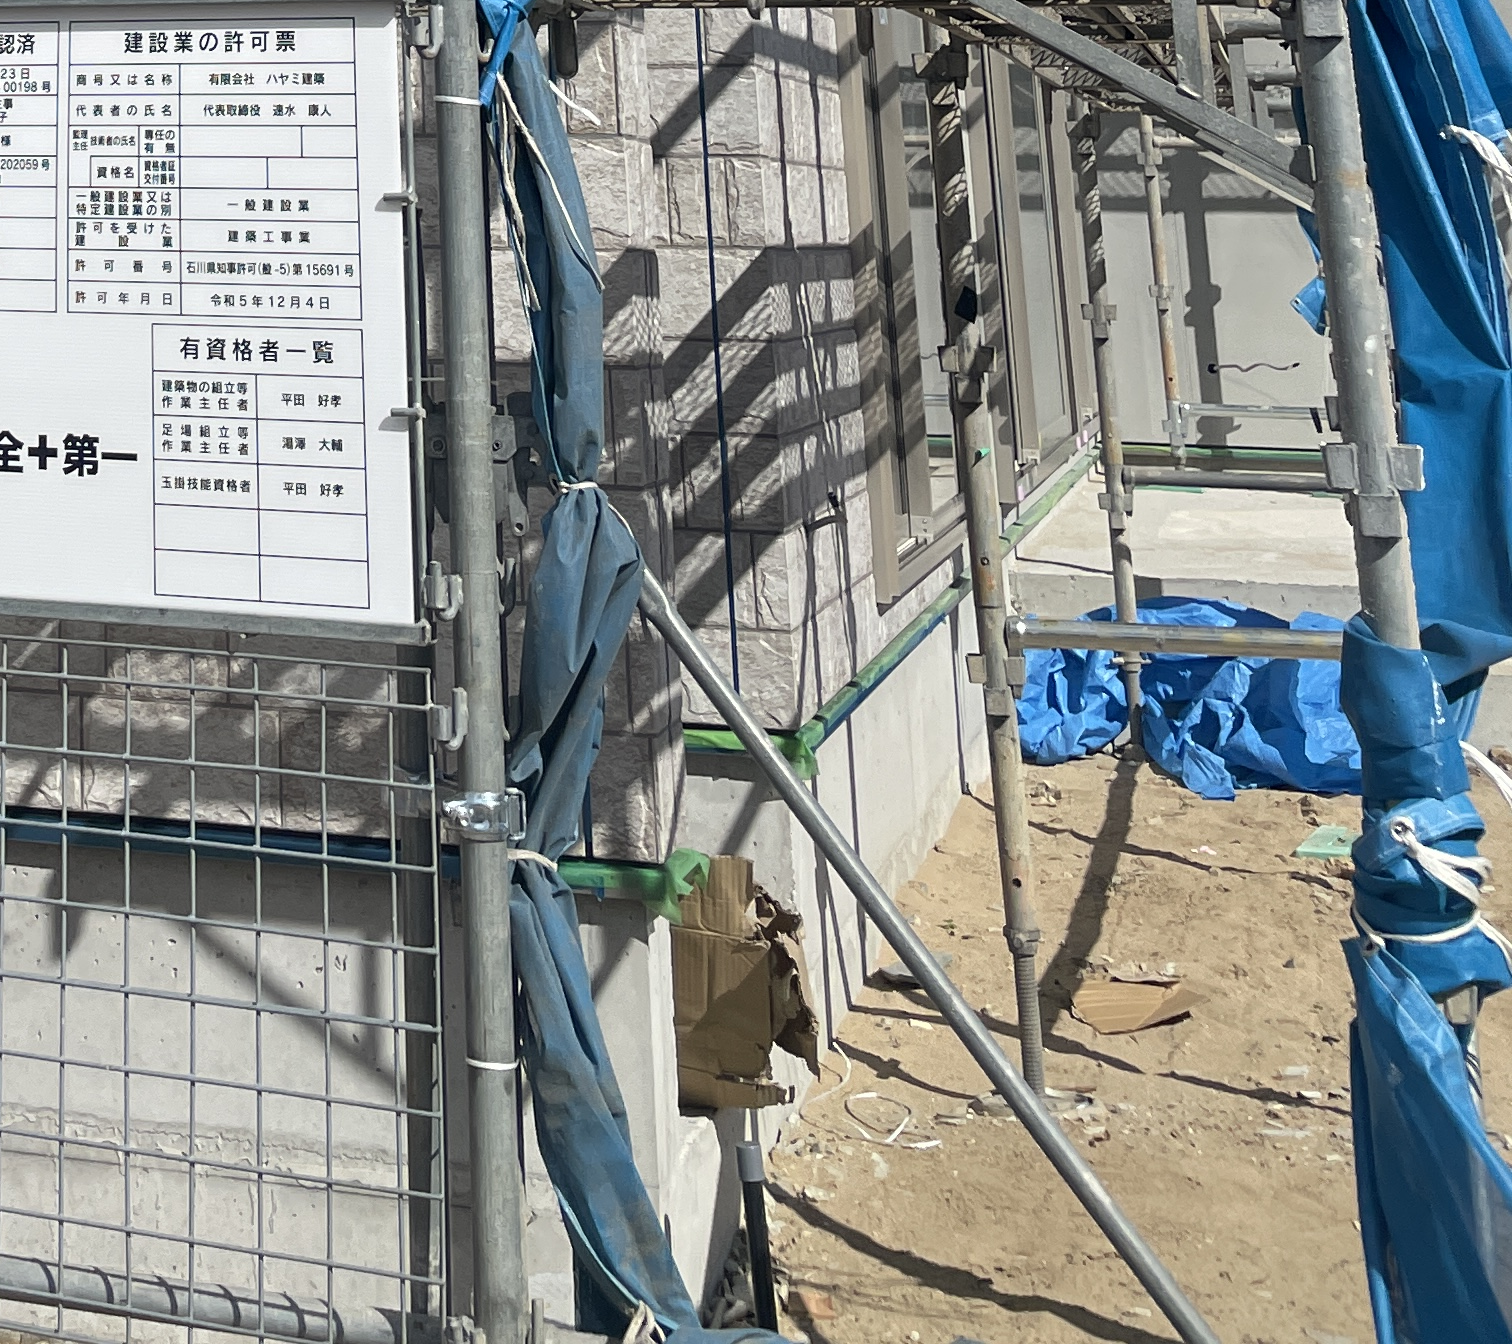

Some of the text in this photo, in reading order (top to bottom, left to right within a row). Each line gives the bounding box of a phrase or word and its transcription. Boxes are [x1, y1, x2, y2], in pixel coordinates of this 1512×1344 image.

[124, 30, 296, 53] 建設業の許可票
[77, 74, 172, 86] 商号又は名称
[209, 73, 324, 85] 有限会社 ハヤミ建築
[76, 104, 171, 116] 代表者の氏名
[204, 104, 260, 116] 代表取締役
[97, 166, 134, 178] 資格名
[76, 191, 171, 204] 一般建設業又は
[76, 203, 171, 216] 特定建設業の別
[228, 199, 309, 212] 一般建設業
[76, 222, 171, 234] 許可を受けた
[228, 230, 310, 243] 建築工事業
[75, 259, 172, 273] 許可番号
[76, 291, 172, 305] 許可年月日
[211, 294, 329, 309] 令和5年12月4日
[180, 337, 333, 363] 有資格者一覧
[162, 396, 248, 411] 作業主任者
[281, 393, 304, 406] 平田
[162, 439, 248, 455] 作業主任者
[161, 476, 250, 492] 玉掛技能資格者
[283, 482, 306, 495] 平田
